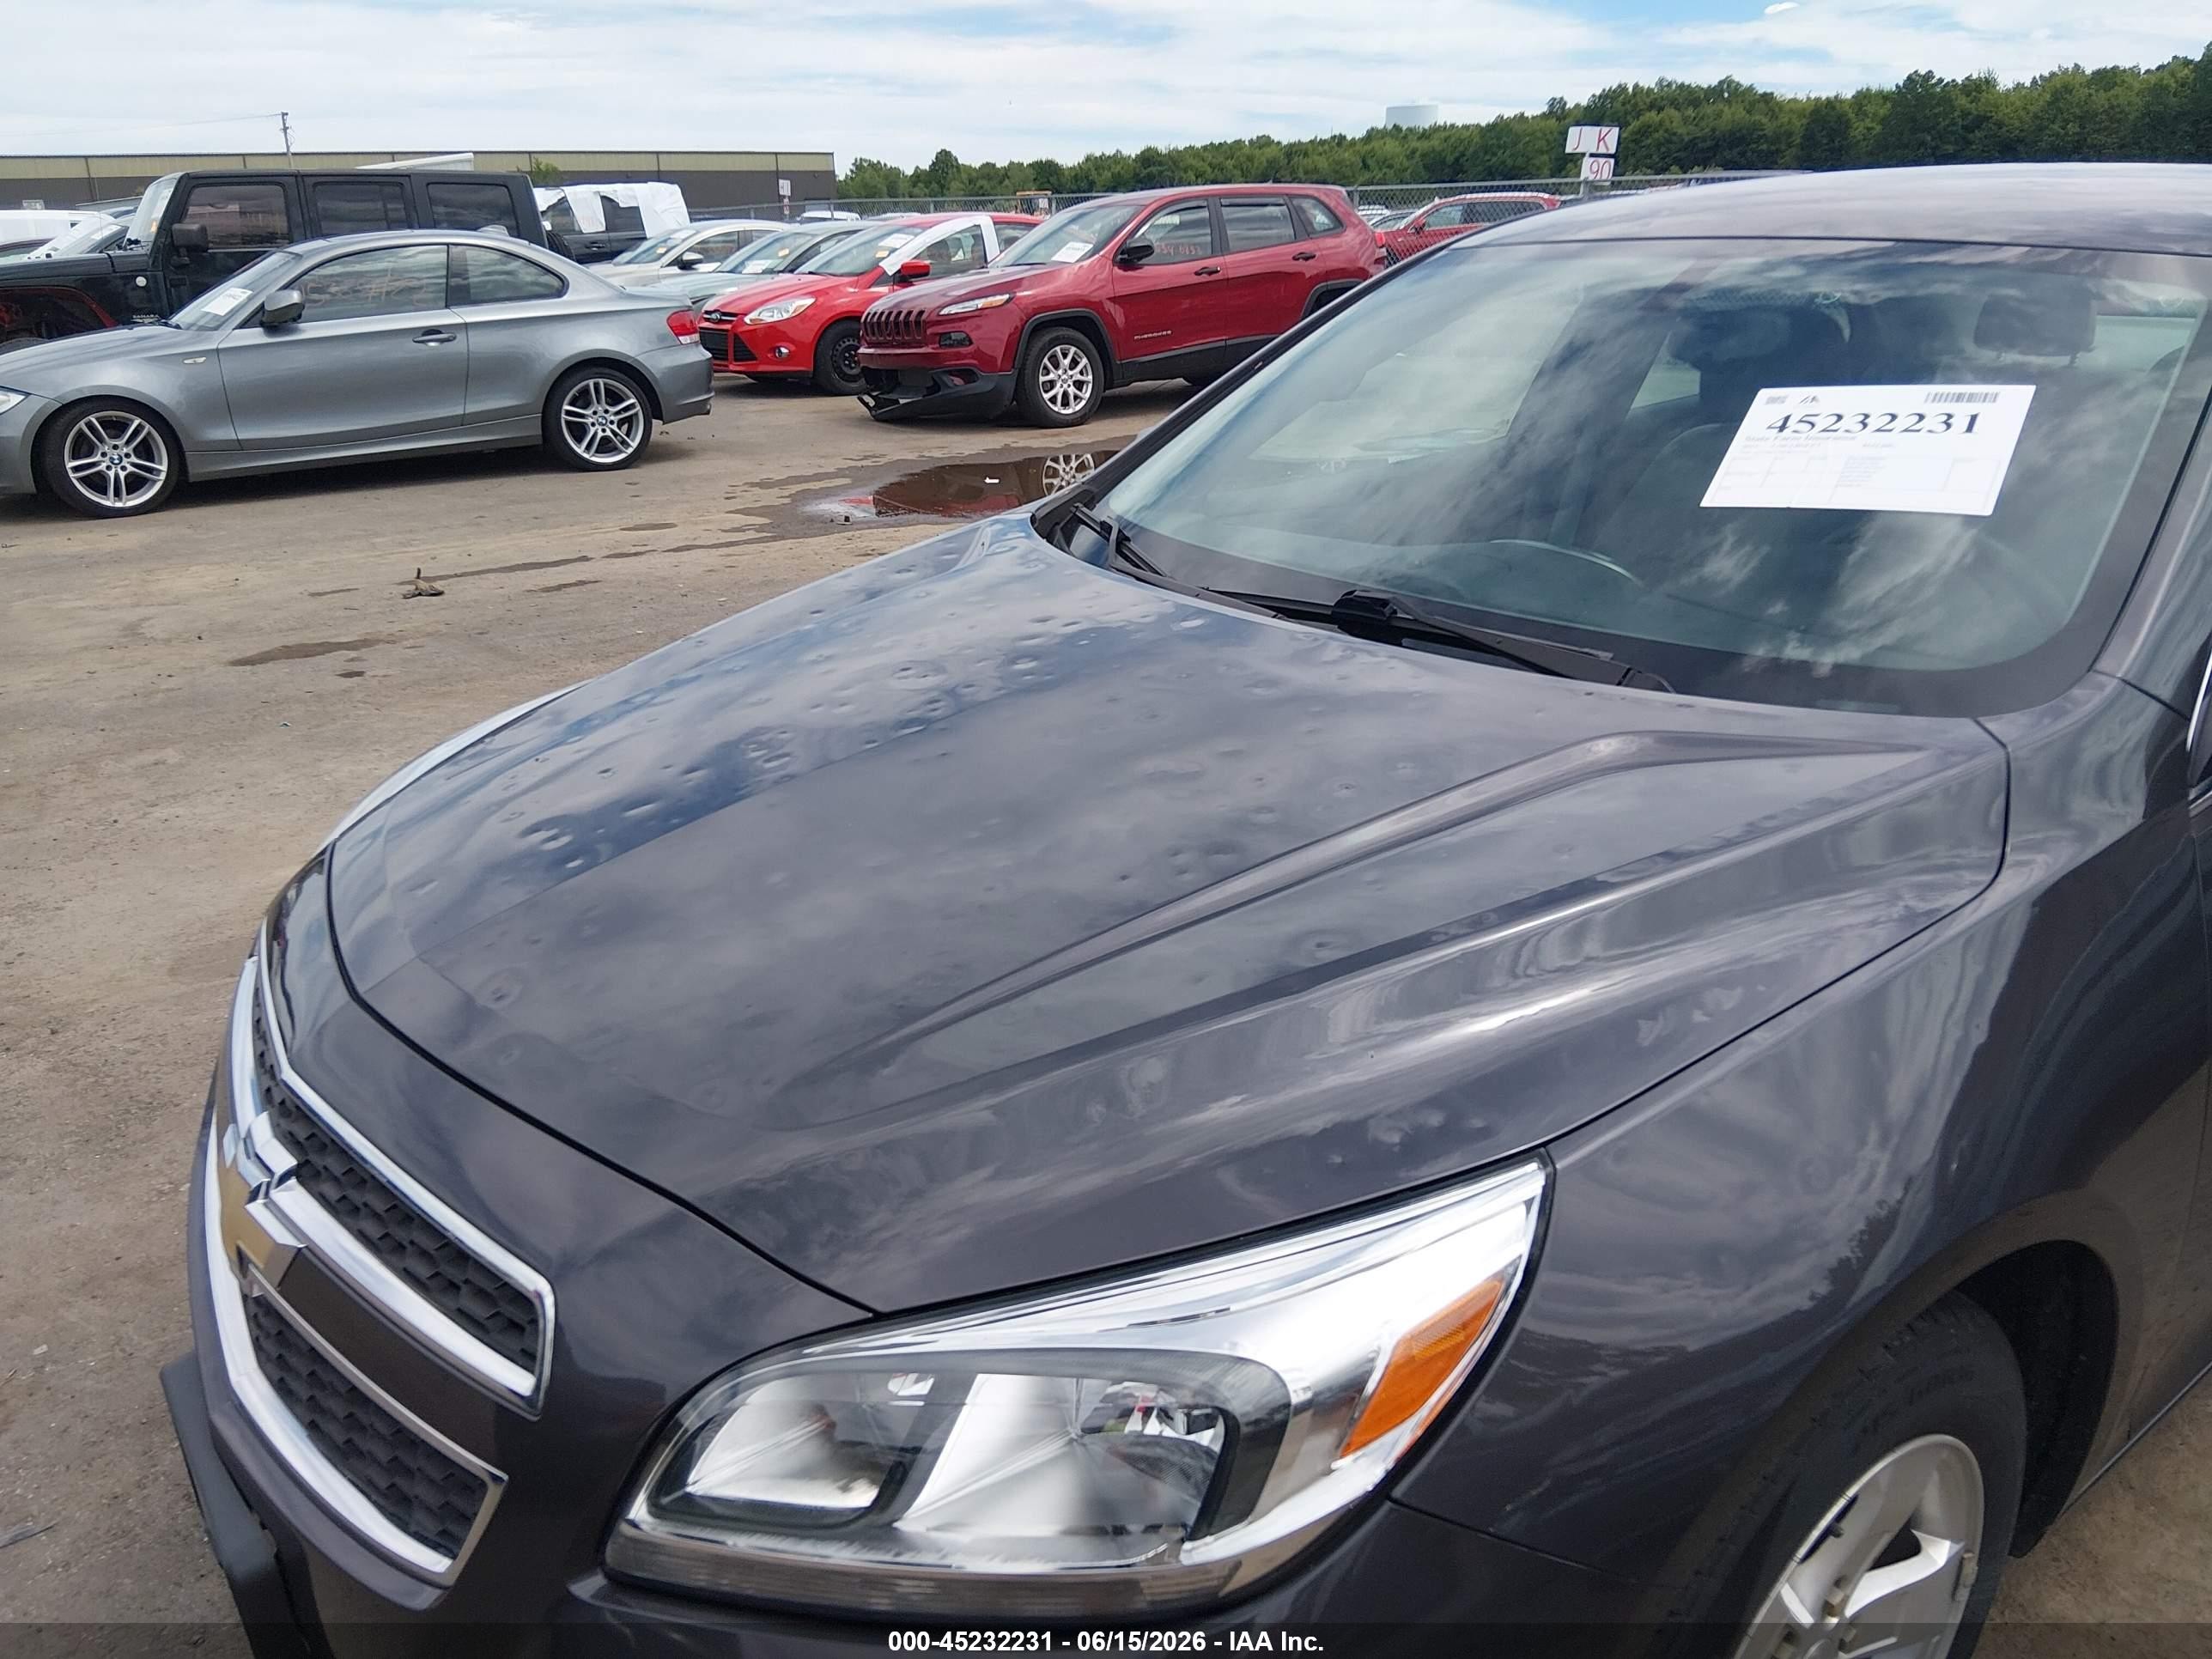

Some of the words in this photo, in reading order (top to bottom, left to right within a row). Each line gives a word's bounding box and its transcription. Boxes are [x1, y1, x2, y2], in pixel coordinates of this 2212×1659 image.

[1572, 127, 1583, 150] J
[1596, 128, 1612, 151] K
[1589, 160, 1611, 179] 90
[1765, 411, 1982, 435] 45232231
